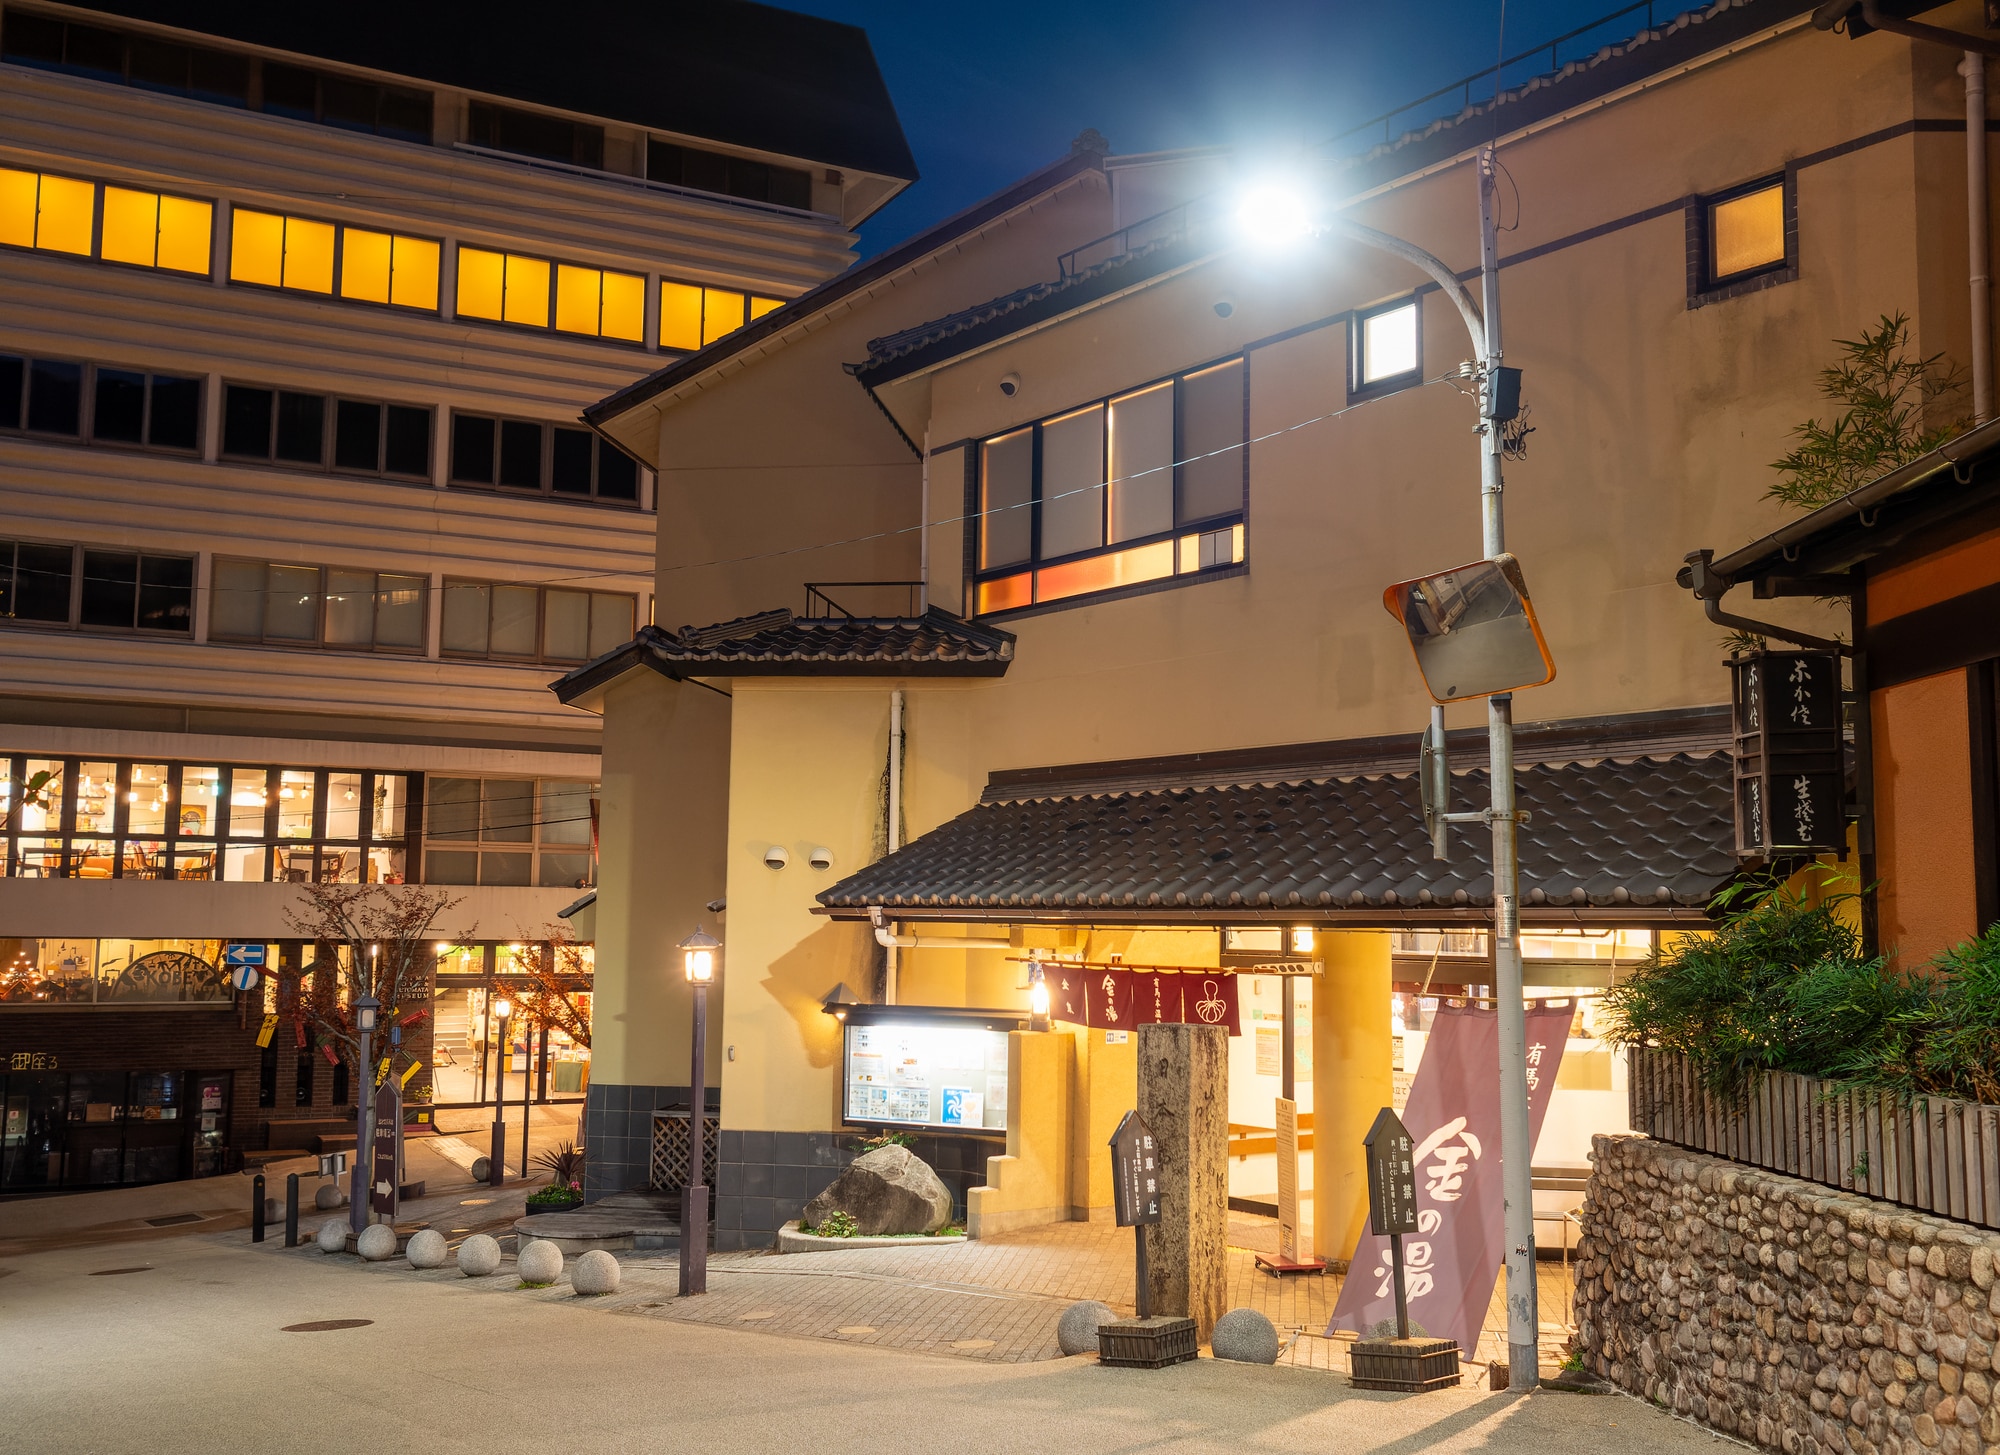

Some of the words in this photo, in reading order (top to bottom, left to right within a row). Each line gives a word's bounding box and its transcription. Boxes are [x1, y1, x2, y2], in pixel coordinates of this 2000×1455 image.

[1102, 974, 1118, 1022] 金の湯
[1143, 1135, 1158, 1215] 駐車禁止
[1373, 1116, 1482, 1304] 金の湯
[1399, 1136, 1414, 1224] 駐車禁止
